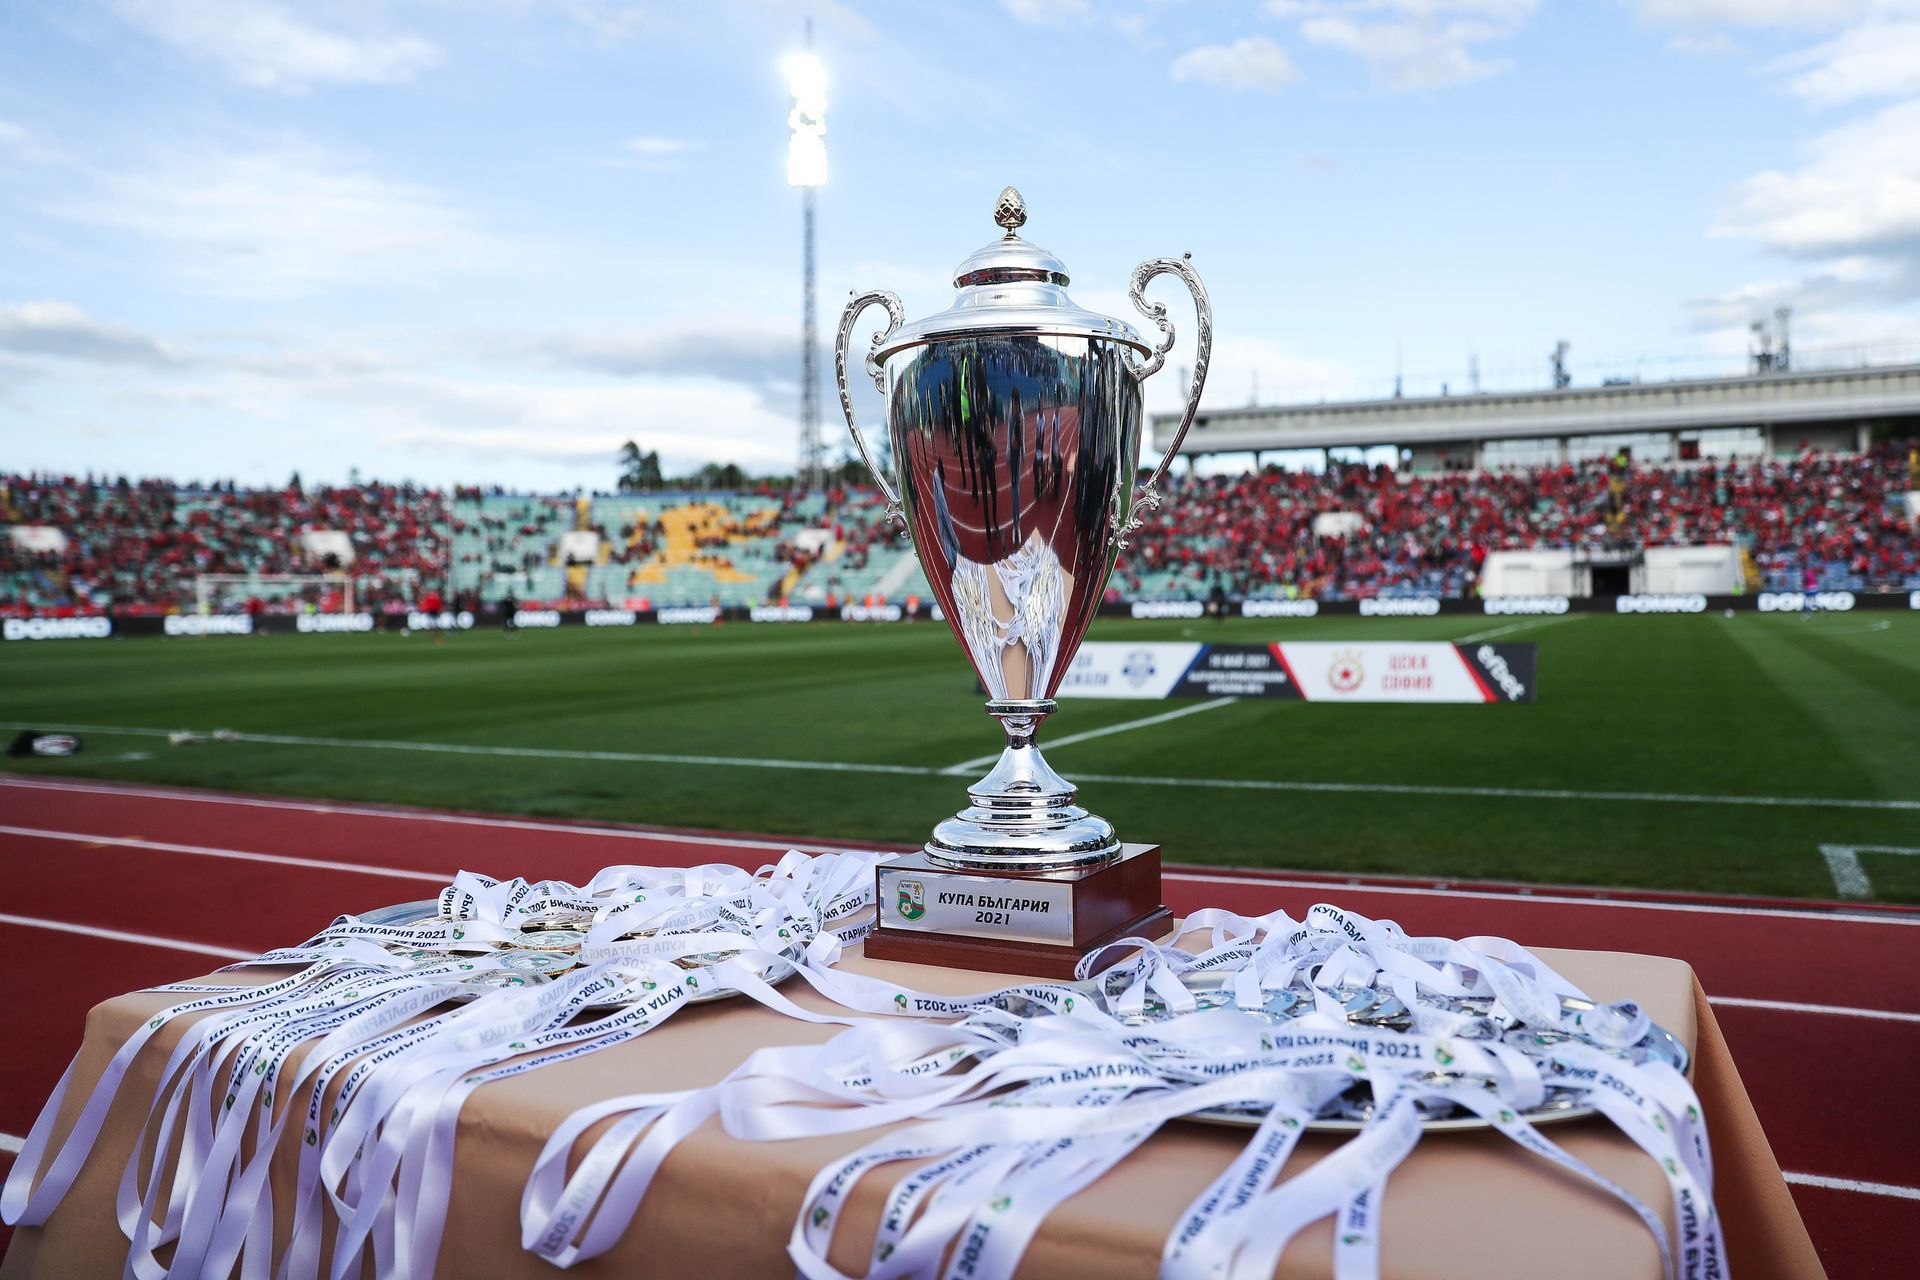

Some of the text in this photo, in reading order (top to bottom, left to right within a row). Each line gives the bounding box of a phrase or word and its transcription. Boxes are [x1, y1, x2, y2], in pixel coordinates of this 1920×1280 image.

[1477, 645, 1526, 701] efbet
[511, 885, 530, 904] 2021
[840, 896, 863, 913] 2021
[938, 892, 1050, 913] КУПА БЪЛГАРИЯ
[975, 911, 1010, 925] 2021
[1313, 906, 1367, 943] КУПА БЪЛГ
[349, 926, 415, 939] БЪЛГАРИЯ
[416, 929, 448, 940] 2021
[838, 926, 867, 942] ЛГАРИЯ
[172, 1000, 214, 1014] КУПА
[217, 979, 296, 1005] БЪЛГАРИЯ
[299, 958, 332, 982] 2021
[578, 980, 605, 999] 2021
[1025, 988, 1059, 1006] КУПА
[297, 1000, 335, 1016] КУПА
[648, 985, 684, 1011] КУПА
[914, 999, 948, 1012] 2021
[209, 1009, 292, 1043] БЪЛГАРИЯ
[269, 1025, 308, 1052] КУПА
[311, 997, 387, 1029] БЪЛГАРИЯ
[388, 985, 422, 998] 2021
[576, 1007, 648, 1037] БЪЛГАРИЯ
[531, 1030, 573, 1046] 2021
[1375, 1042, 1424, 1059] 2021
[309, 1079, 326, 1122] КУПА
[325, 1033, 403, 1075] БЪЛГАРИЯ
[407, 1019, 442, 1037] 2021
[340, 1064, 370, 1101] 2021
[1601, 1074, 1645, 1107] 2021
[886, 1183, 920, 1233] КУПА
[1680, 1188, 1700, 1243] КУПА
